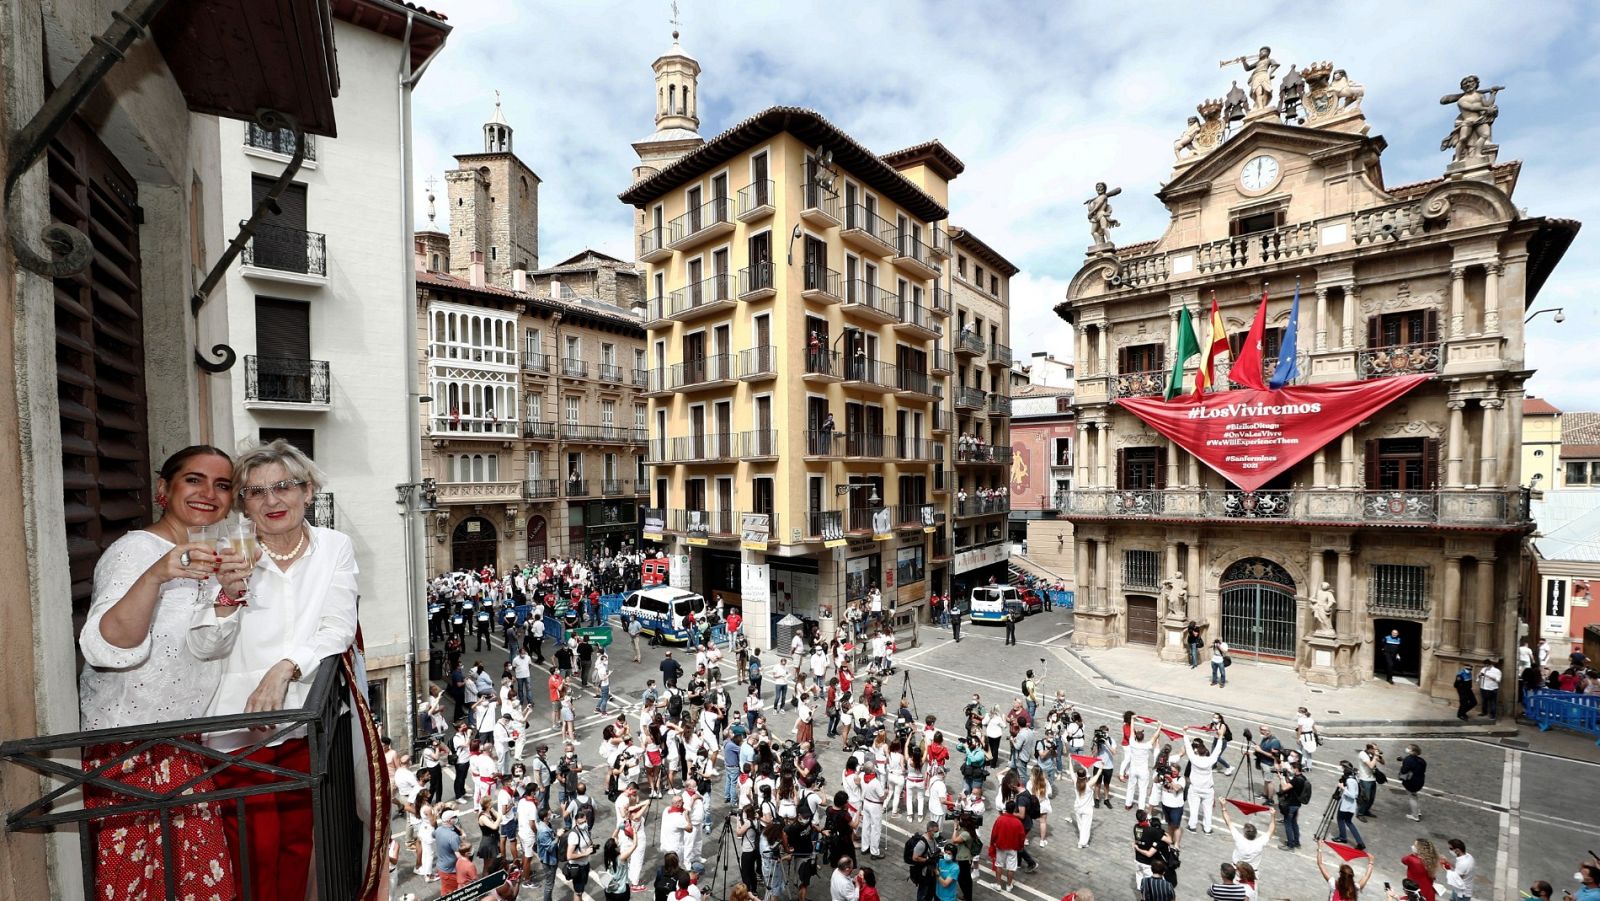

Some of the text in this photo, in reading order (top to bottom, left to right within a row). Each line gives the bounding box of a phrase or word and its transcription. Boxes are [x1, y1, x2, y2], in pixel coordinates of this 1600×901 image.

[1187, 402, 1321, 419] #LosViviremos
[1223, 430, 1282, 438] #OnVaLesVivre
[1206, 437, 1299, 447] #WeWillExperienceThem
[1552, 580, 1560, 616] ZENTRAL
